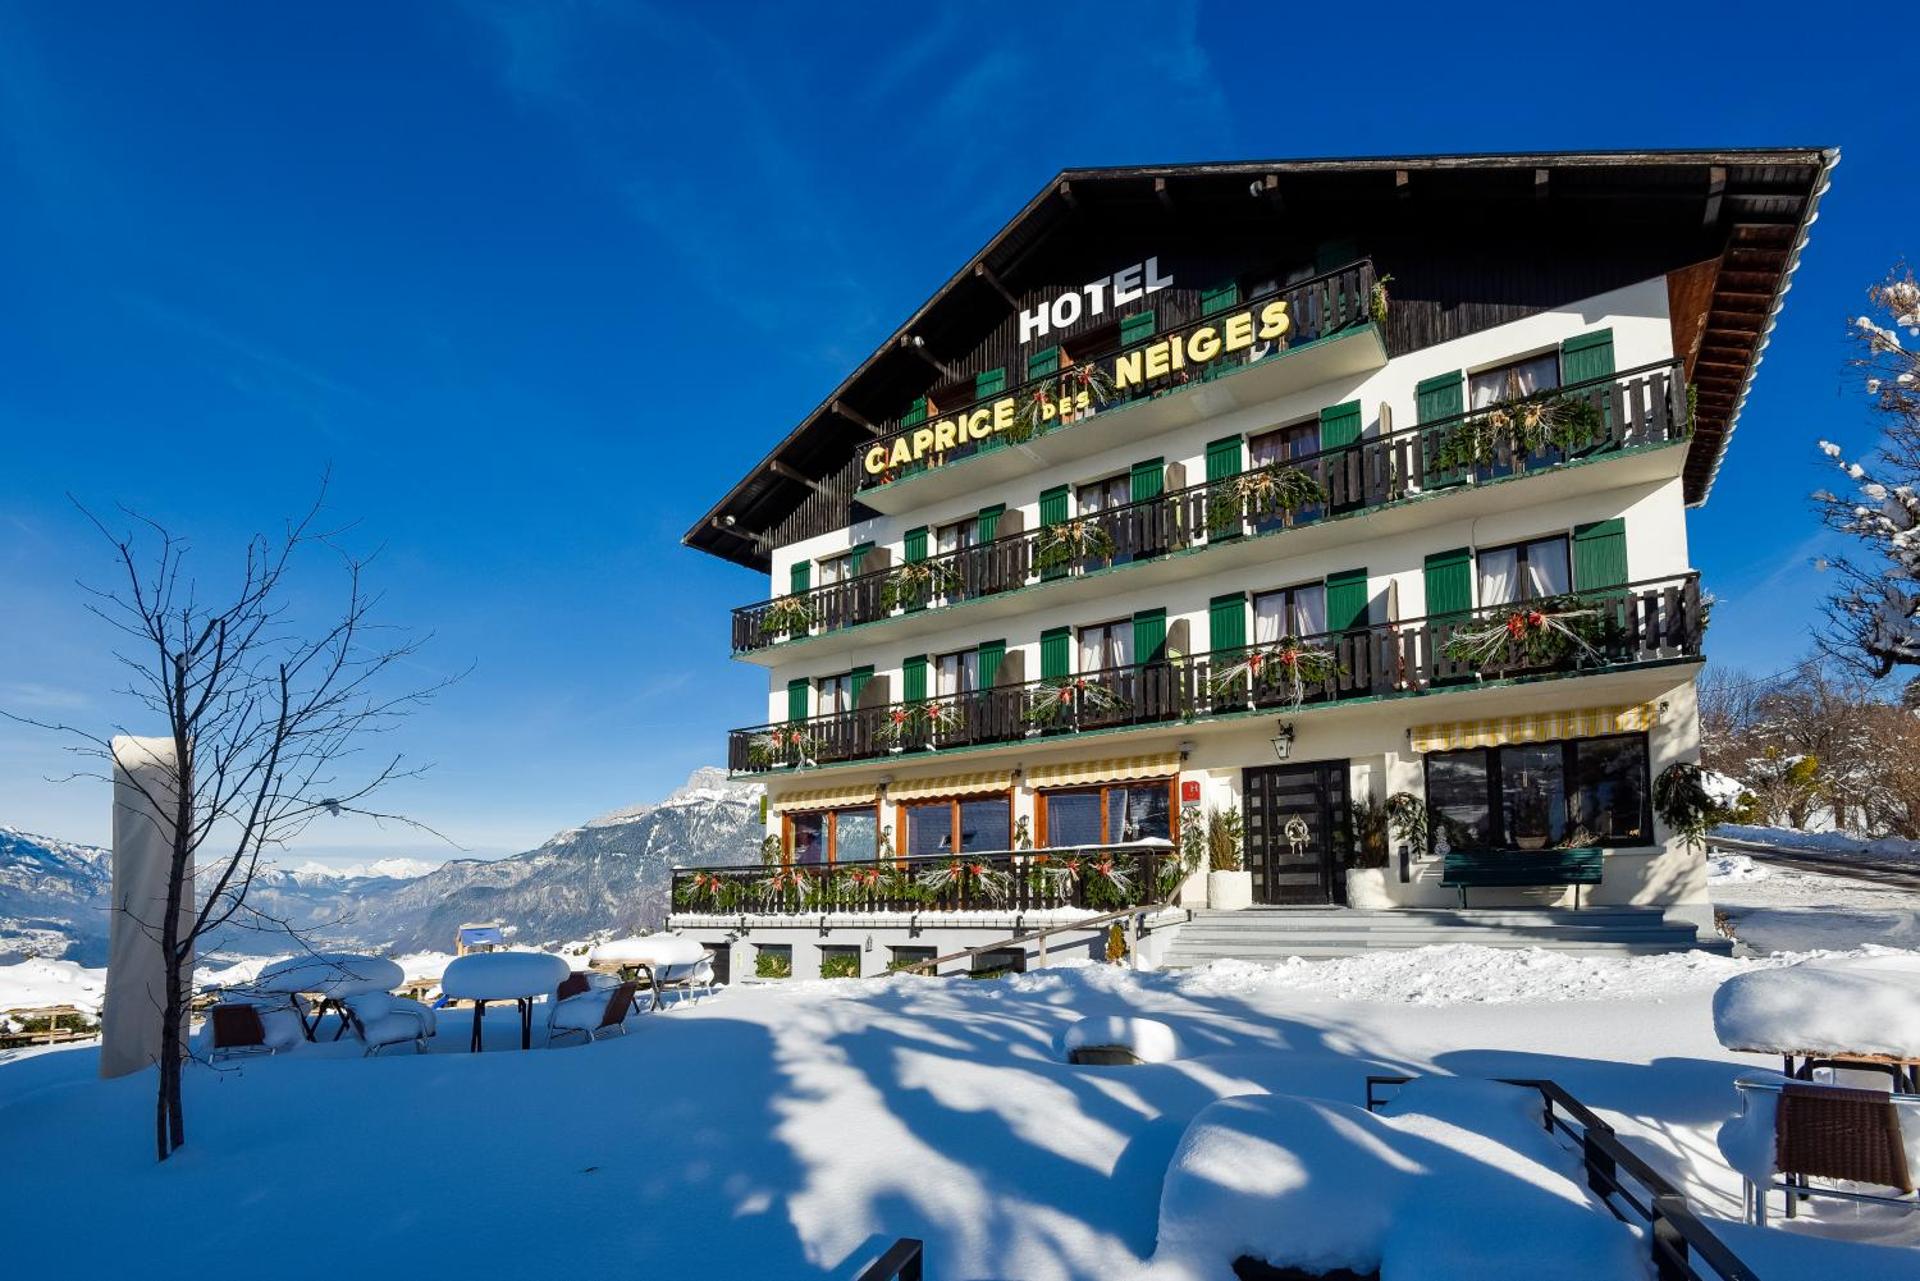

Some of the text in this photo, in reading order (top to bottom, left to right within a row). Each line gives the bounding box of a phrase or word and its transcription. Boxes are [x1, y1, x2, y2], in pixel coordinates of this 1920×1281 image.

[1019, 257, 1173, 343] HOTEL
[864, 302, 1290, 474] CAPRICE DES NEIGES
